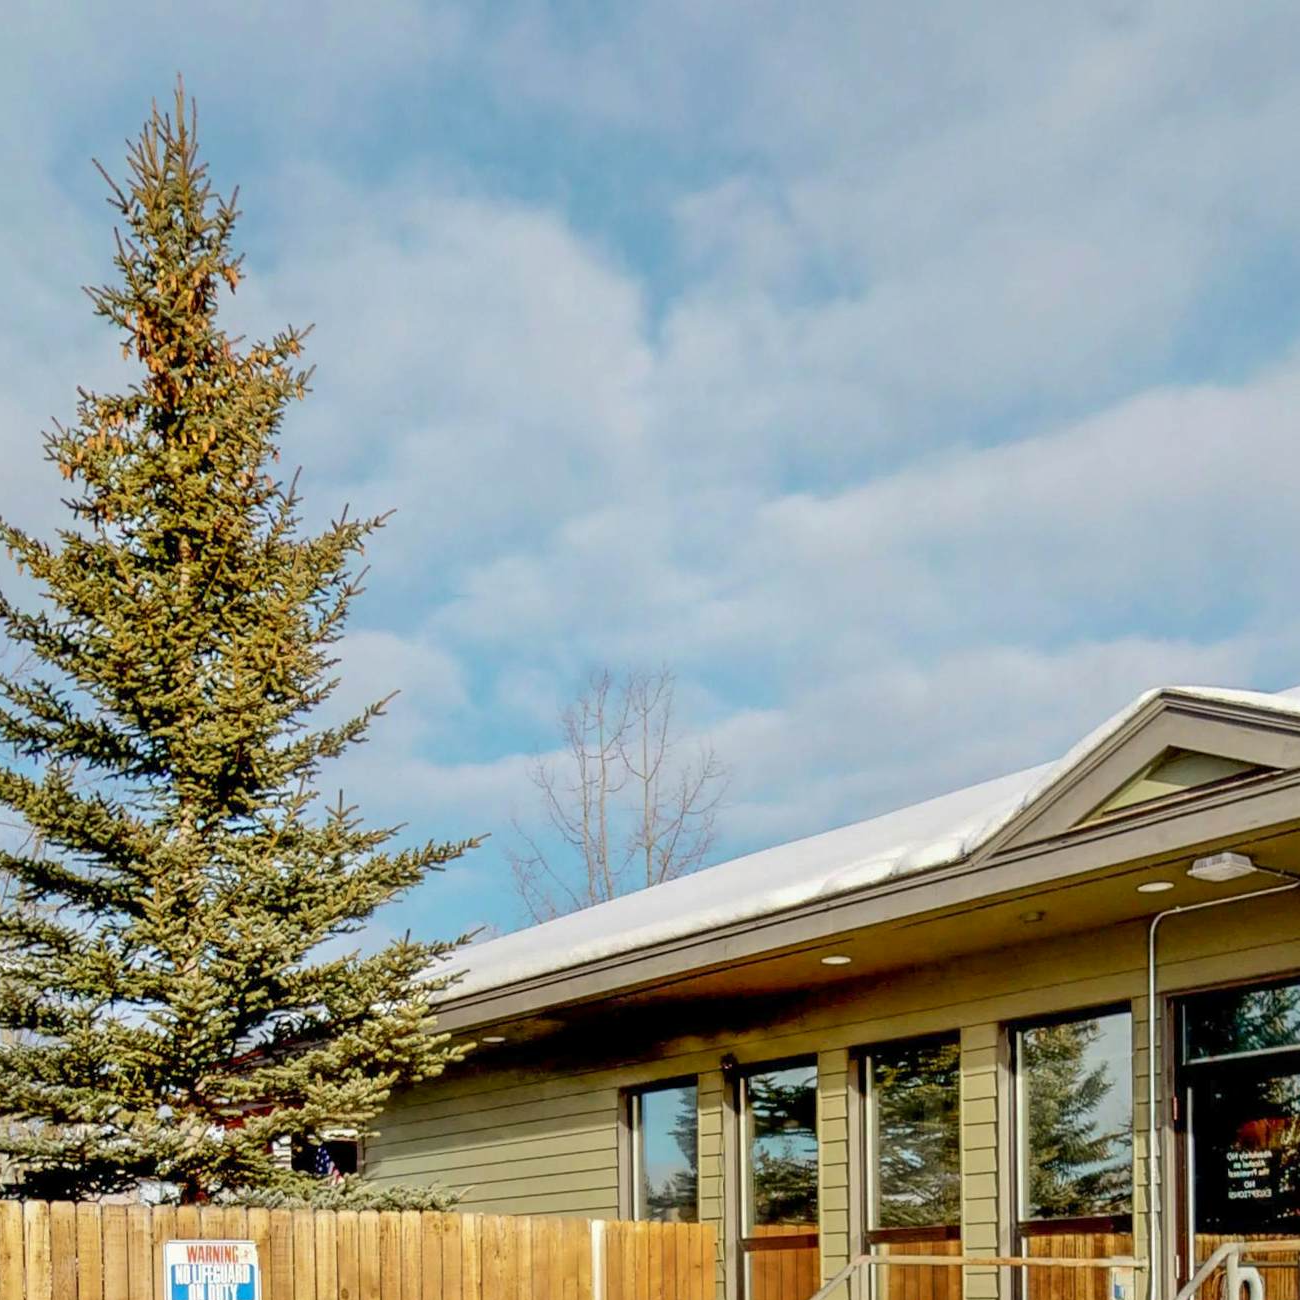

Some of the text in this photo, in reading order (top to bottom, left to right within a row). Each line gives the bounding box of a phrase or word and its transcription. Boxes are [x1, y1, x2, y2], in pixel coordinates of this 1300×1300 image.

[187, 1245, 238, 1264] WARNING
[175, 1264, 251, 1284] NO LIFEGUARD
